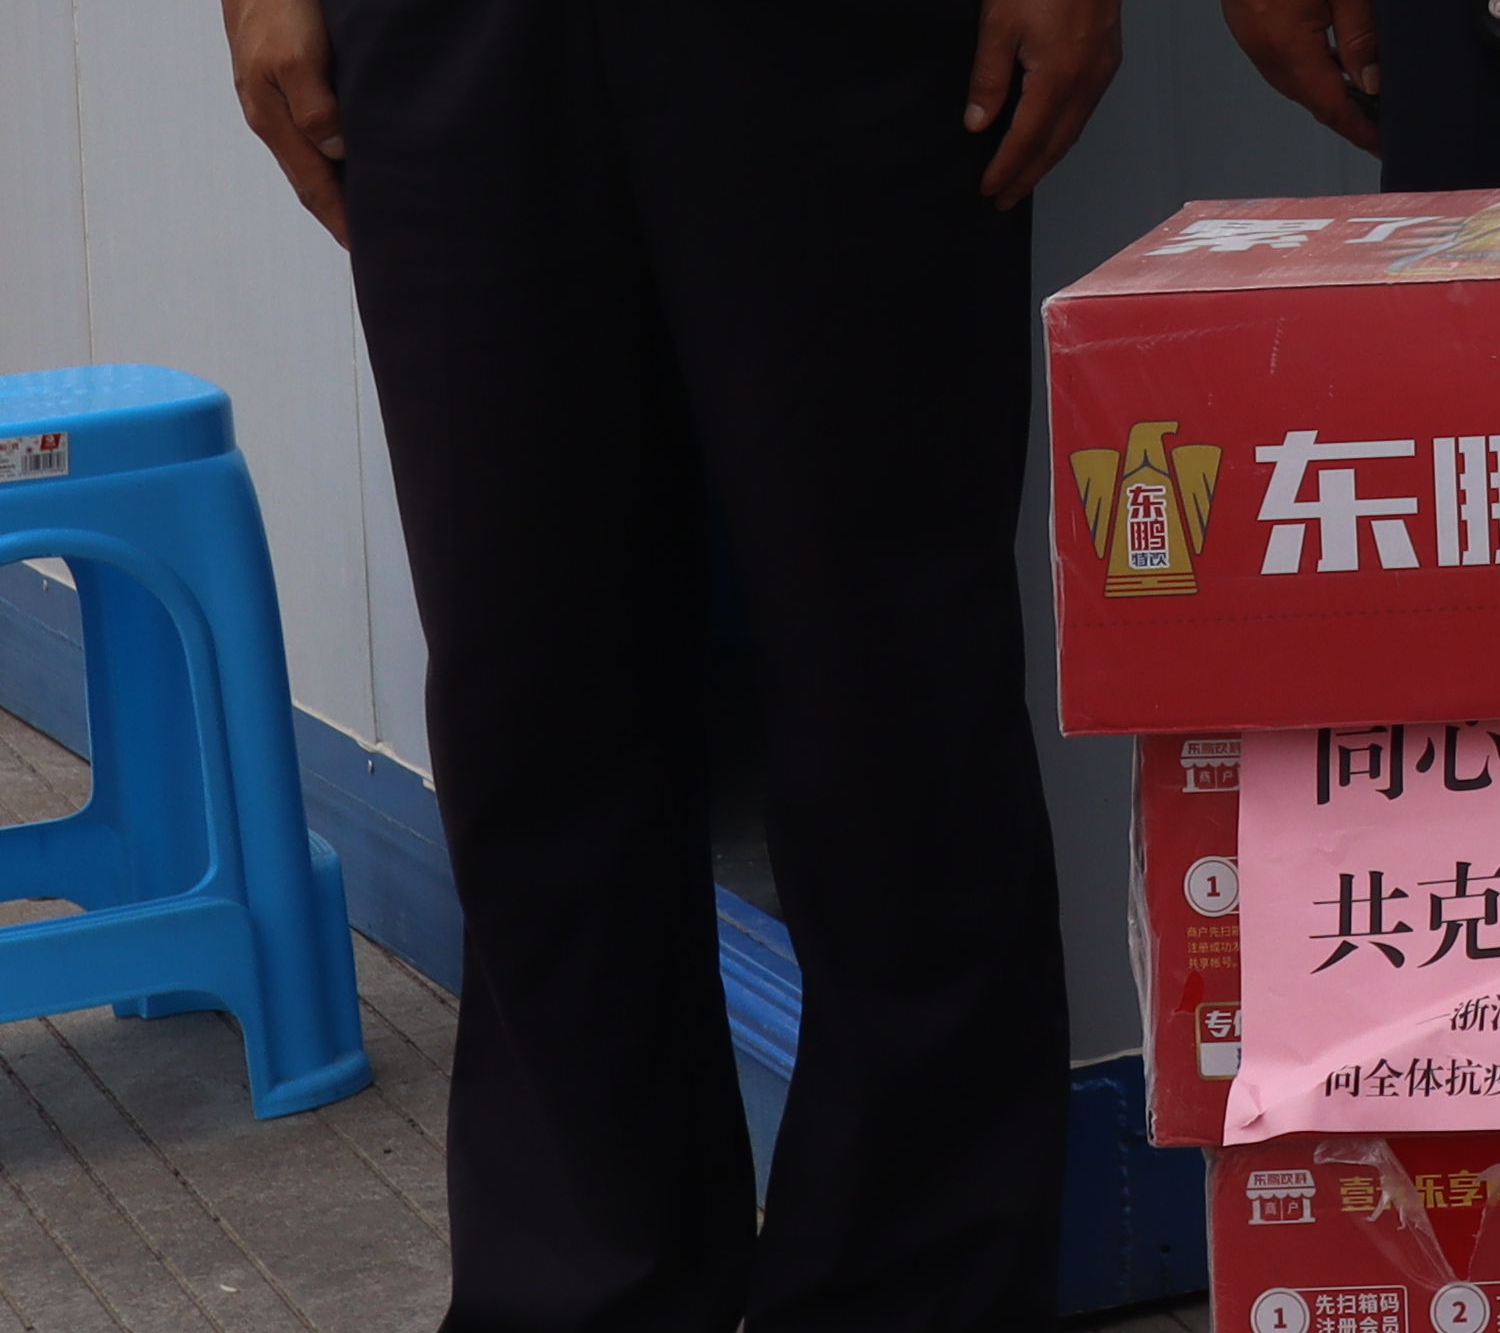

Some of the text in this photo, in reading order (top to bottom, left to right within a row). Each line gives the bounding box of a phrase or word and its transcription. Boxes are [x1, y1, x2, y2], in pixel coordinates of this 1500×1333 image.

[1205, 875, 1222, 898] 1
[1315, 1292, 1400, 1315] 先扫箱码
[1451, 1300, 1468, 1324] 2
[1272, 1307, 1288, 1329] 1
